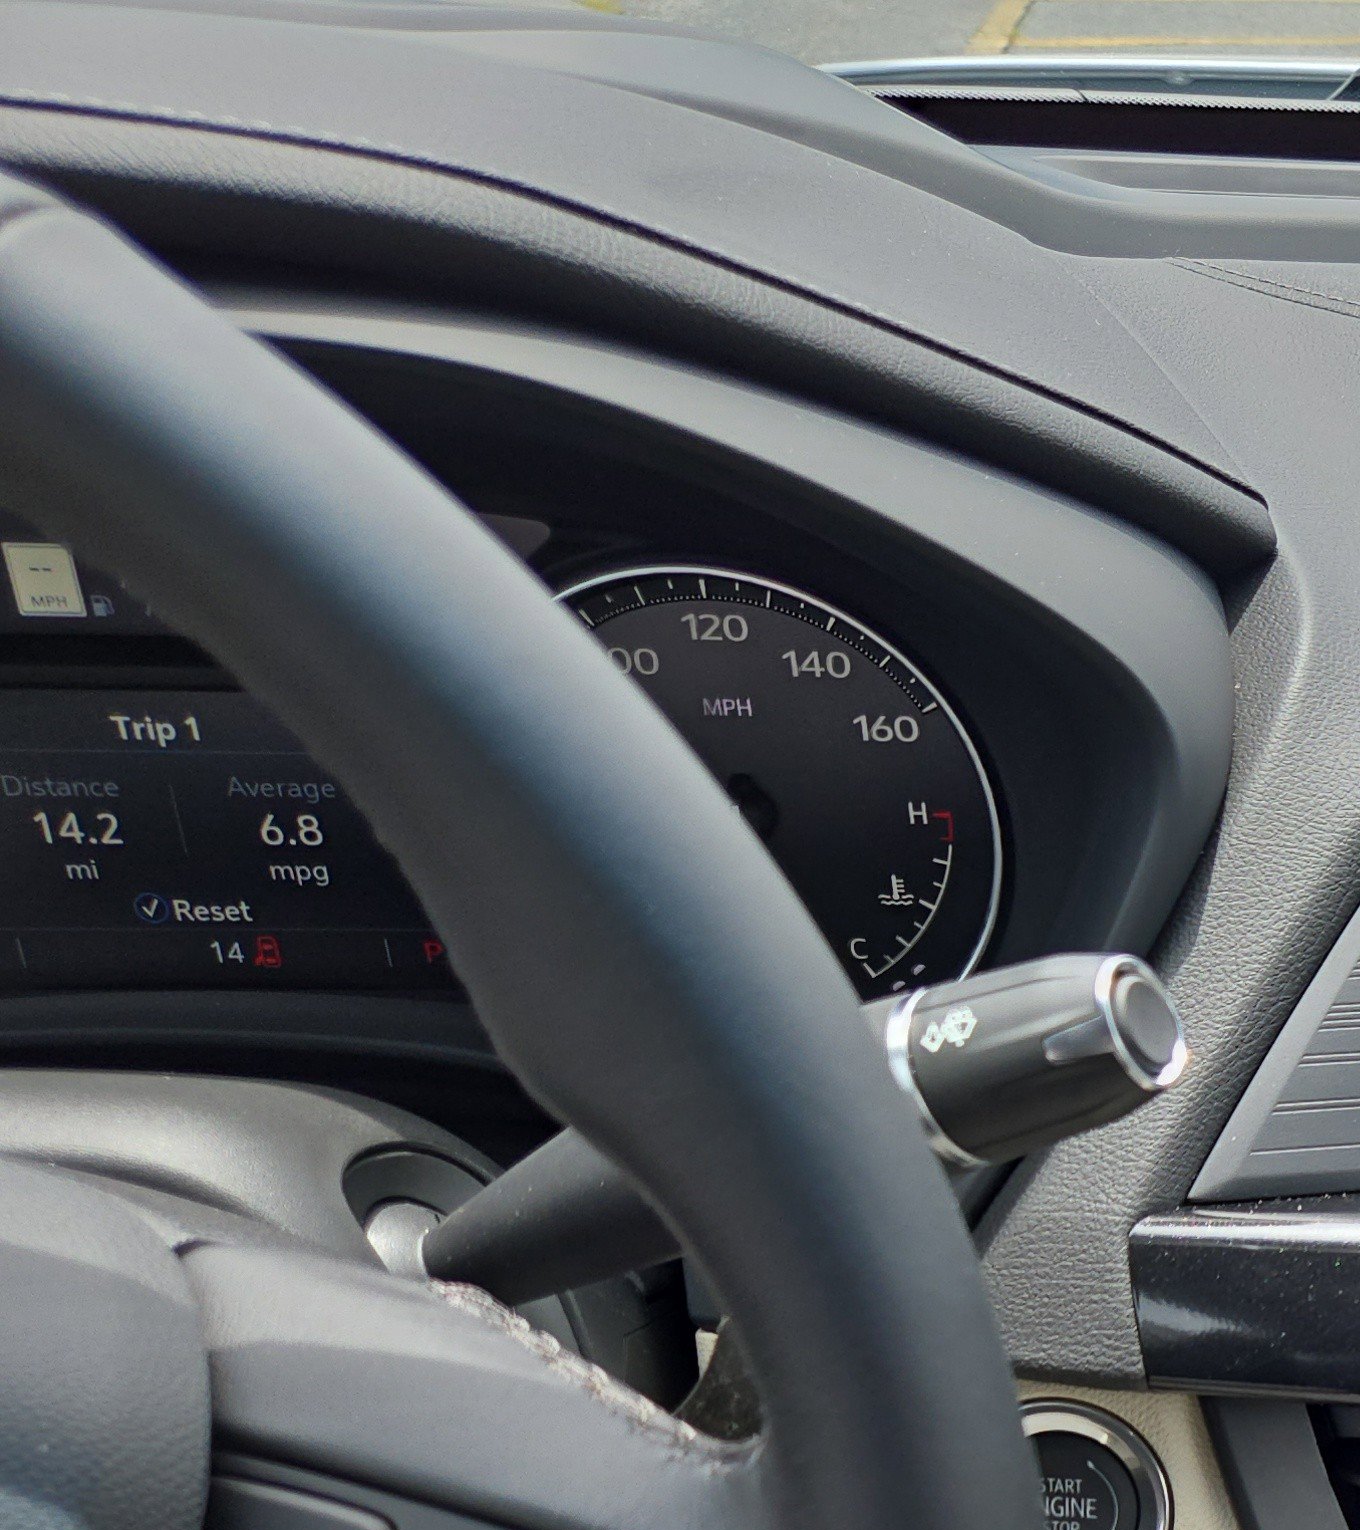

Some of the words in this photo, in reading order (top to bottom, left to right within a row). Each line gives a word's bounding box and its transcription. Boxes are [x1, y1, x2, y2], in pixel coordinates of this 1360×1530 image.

[31, 595, 68, 608] MPH
[680, 612, 748, 642] 120
[606, 647, 659, 676] 00
[781, 649, 851, 679] 140
[702, 697, 753, 717] MPH
[109, 715, 177, 748] Trip
[184, 716, 201, 741] 1
[852, 714, 920, 743] 160
[1, 775, 119, 798] Distance
[227, 776, 336, 804] Average
[907, 801, 929, 825] H
[32, 811, 124, 846] 14.2
[259, 813, 324, 848] 6.8
[65, 858, 100, 881] mi
[269, 863, 330, 887] mpg
[172, 899, 253, 922] Reset
[210, 939, 246, 964] 14
[849, 937, 870, 960] C
[1045, 1496, 1098, 1519] GINE
